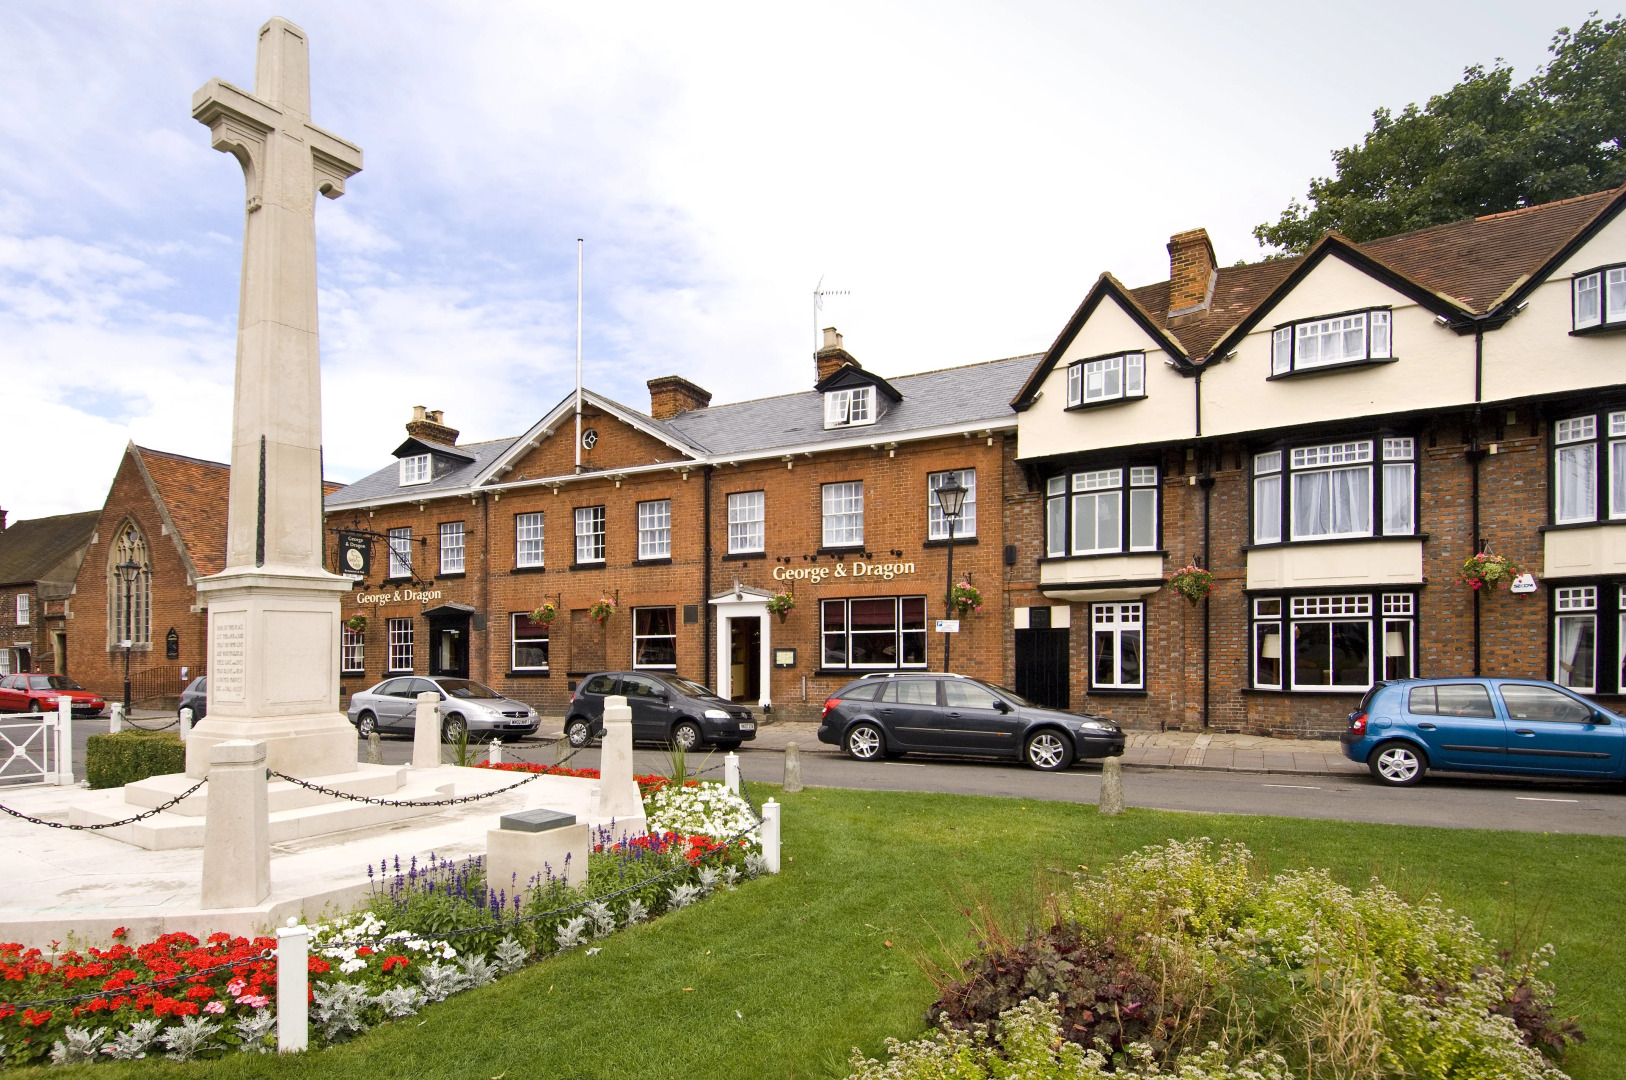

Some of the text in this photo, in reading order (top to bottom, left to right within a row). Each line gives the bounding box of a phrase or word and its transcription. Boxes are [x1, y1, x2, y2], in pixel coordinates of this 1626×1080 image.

[773, 561, 915, 584] George & Dragon
[356, 589, 441, 606] George & Dragon
